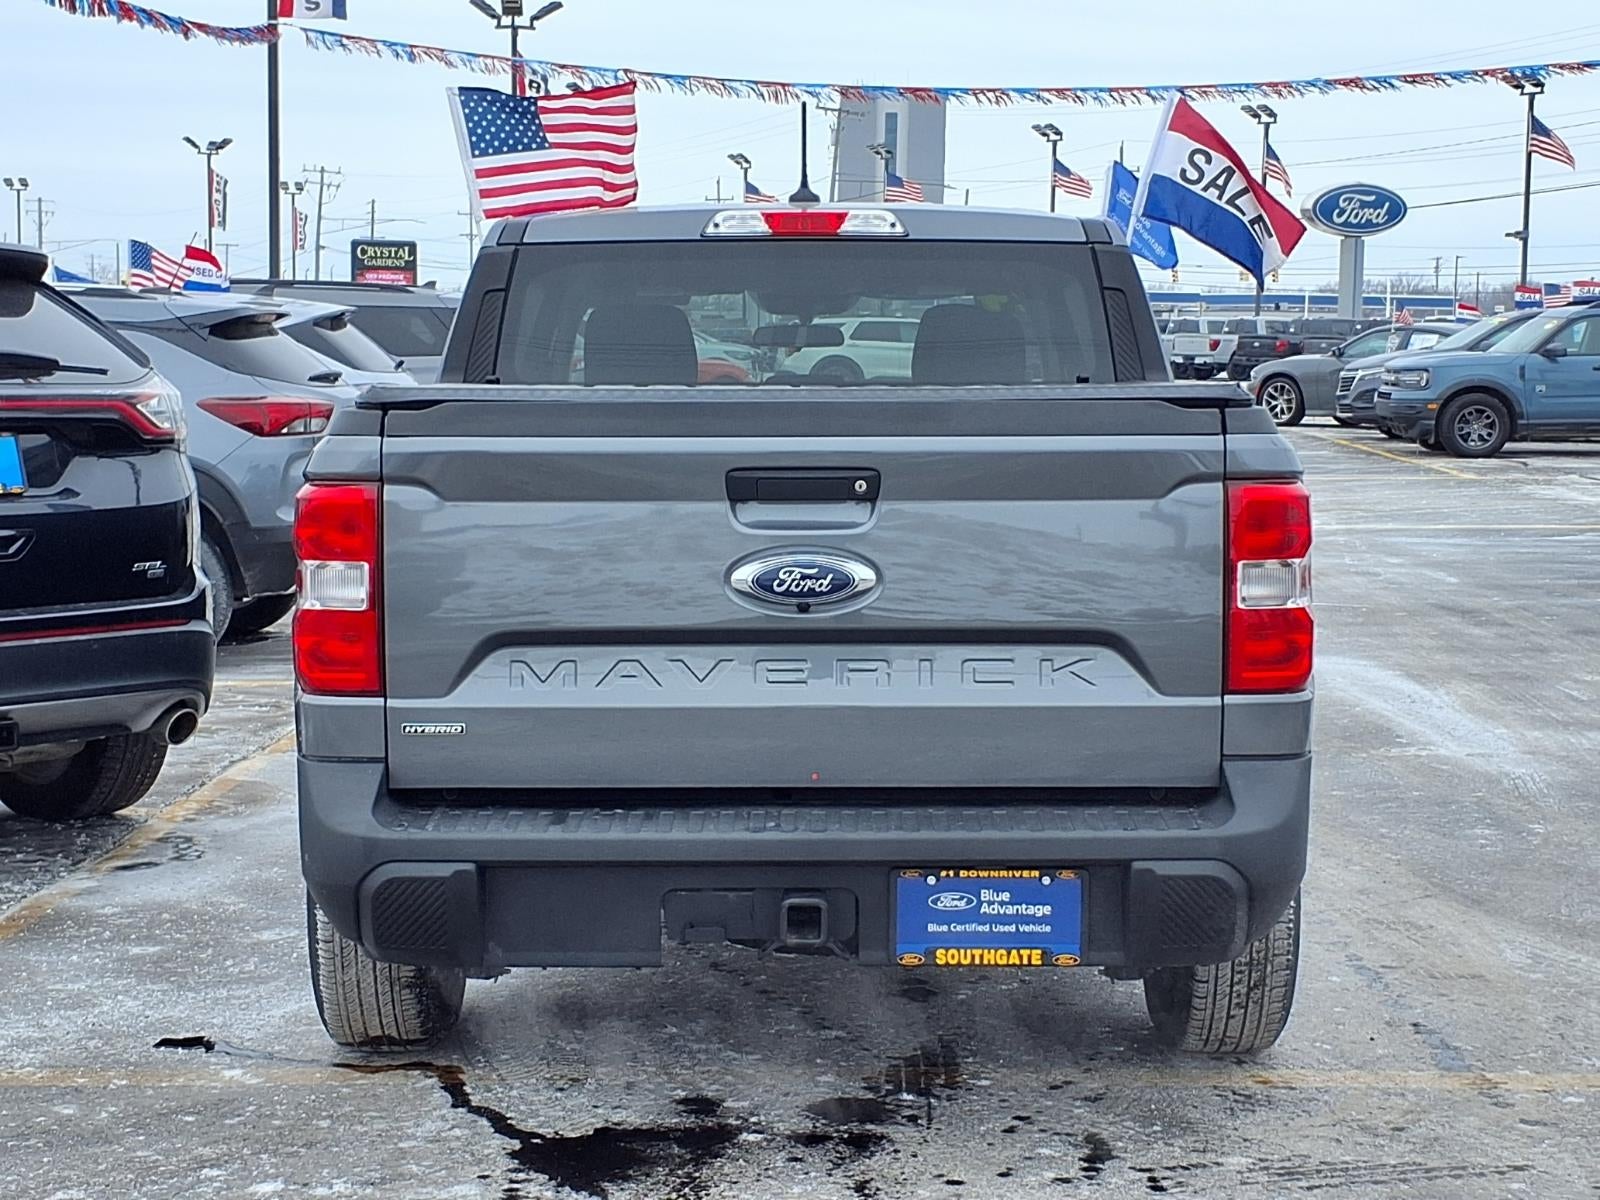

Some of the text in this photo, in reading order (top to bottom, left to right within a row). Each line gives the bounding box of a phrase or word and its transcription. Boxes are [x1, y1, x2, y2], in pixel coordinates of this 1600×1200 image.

[1179, 148, 1274, 245] SALE
[1332, 193, 1390, 224] Ford
[1134, 221, 1167, 258] dvantage
[356, 244, 415, 261] CRYSTAL
[364, 258, 406, 267] GARDENS
[772, 566, 834, 593] Ford
[509, 658, 1098, 689] MAVERICK
[404, 725, 463, 734] HYBRID
[939, 869, 1041, 878] #1 DOWNRIVER
[936, 894, 969, 908] Ford
[980, 889, 1011, 902] Blue
[980, 902, 1052, 917] Advantage
[927, 923, 1052, 933] Blue Certified Used Vehicle
[935, 948, 1043, 965] SOUTHGATE
